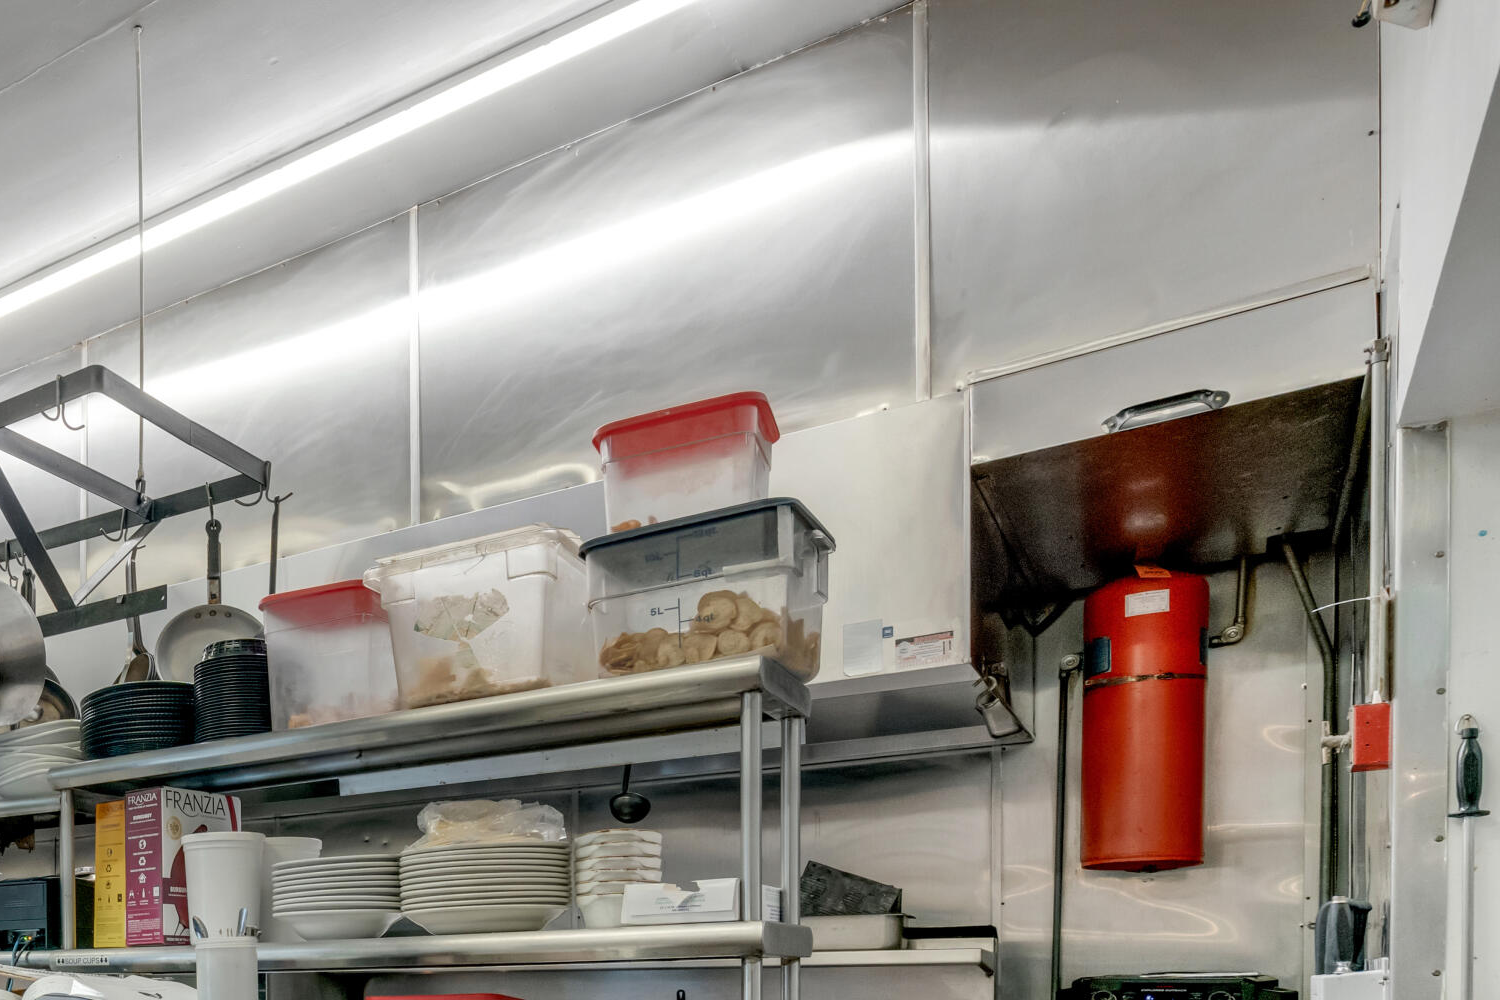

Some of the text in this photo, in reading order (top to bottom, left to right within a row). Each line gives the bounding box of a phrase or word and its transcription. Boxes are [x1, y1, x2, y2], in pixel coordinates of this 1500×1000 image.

[650, 607, 664, 616] 5L
[128, 792, 158, 806] FRANZIA
[165, 789, 226, 818] FRANZIA
[65, 957, 100, 965] SOUP CUPS
